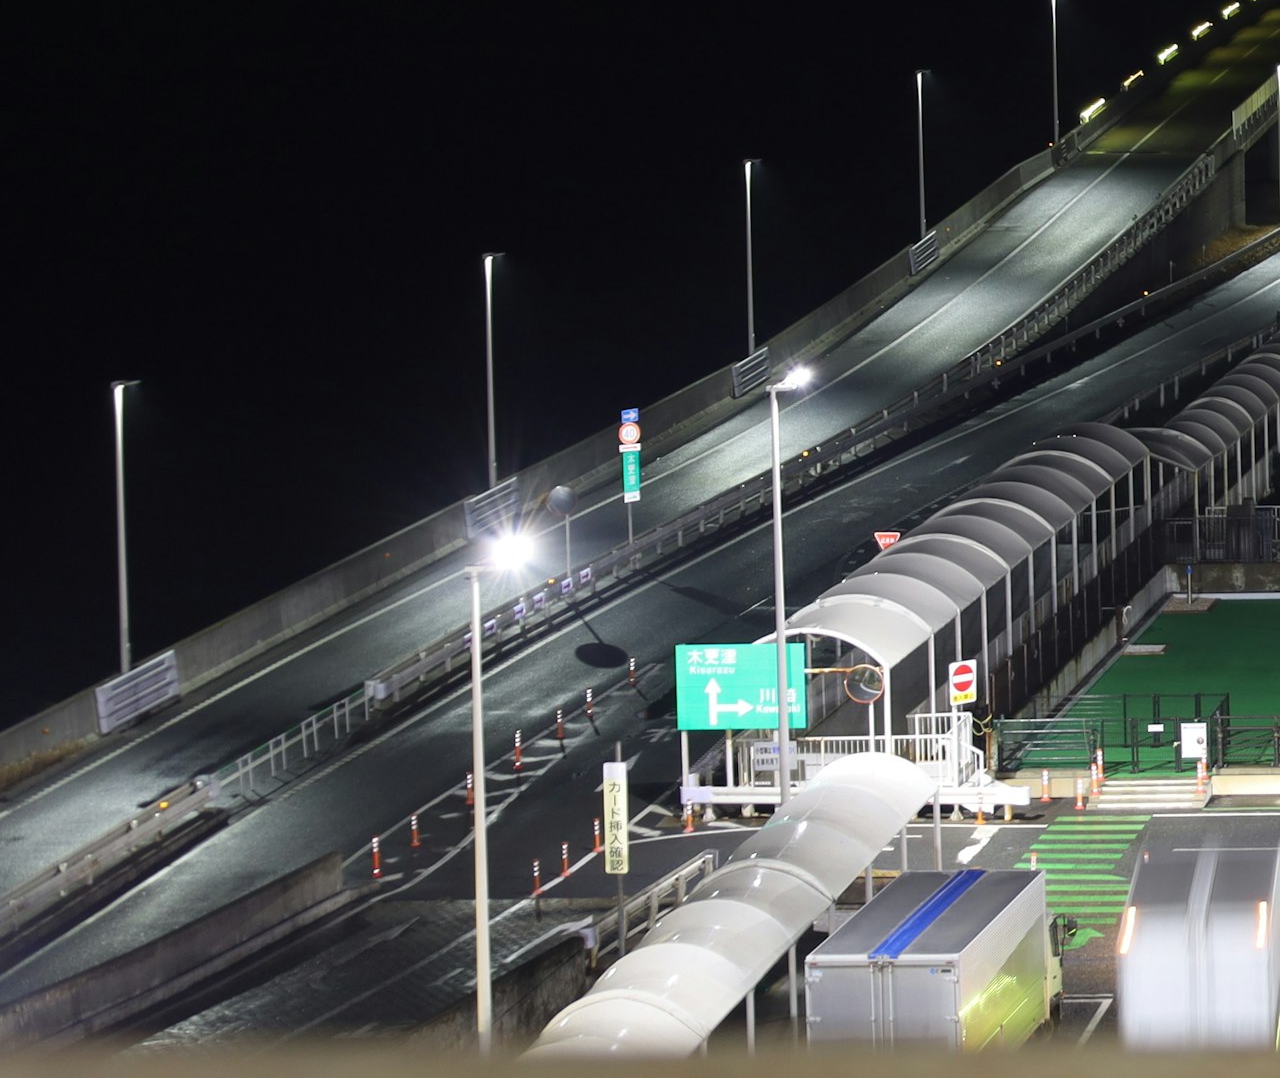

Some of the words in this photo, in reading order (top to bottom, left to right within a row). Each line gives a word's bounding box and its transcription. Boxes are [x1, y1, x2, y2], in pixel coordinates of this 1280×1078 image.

[687, 648, 737, 665] 木更津
[689, 665, 736, 675] Kisarazu
[608, 781, 624, 872] カード挿入確認
